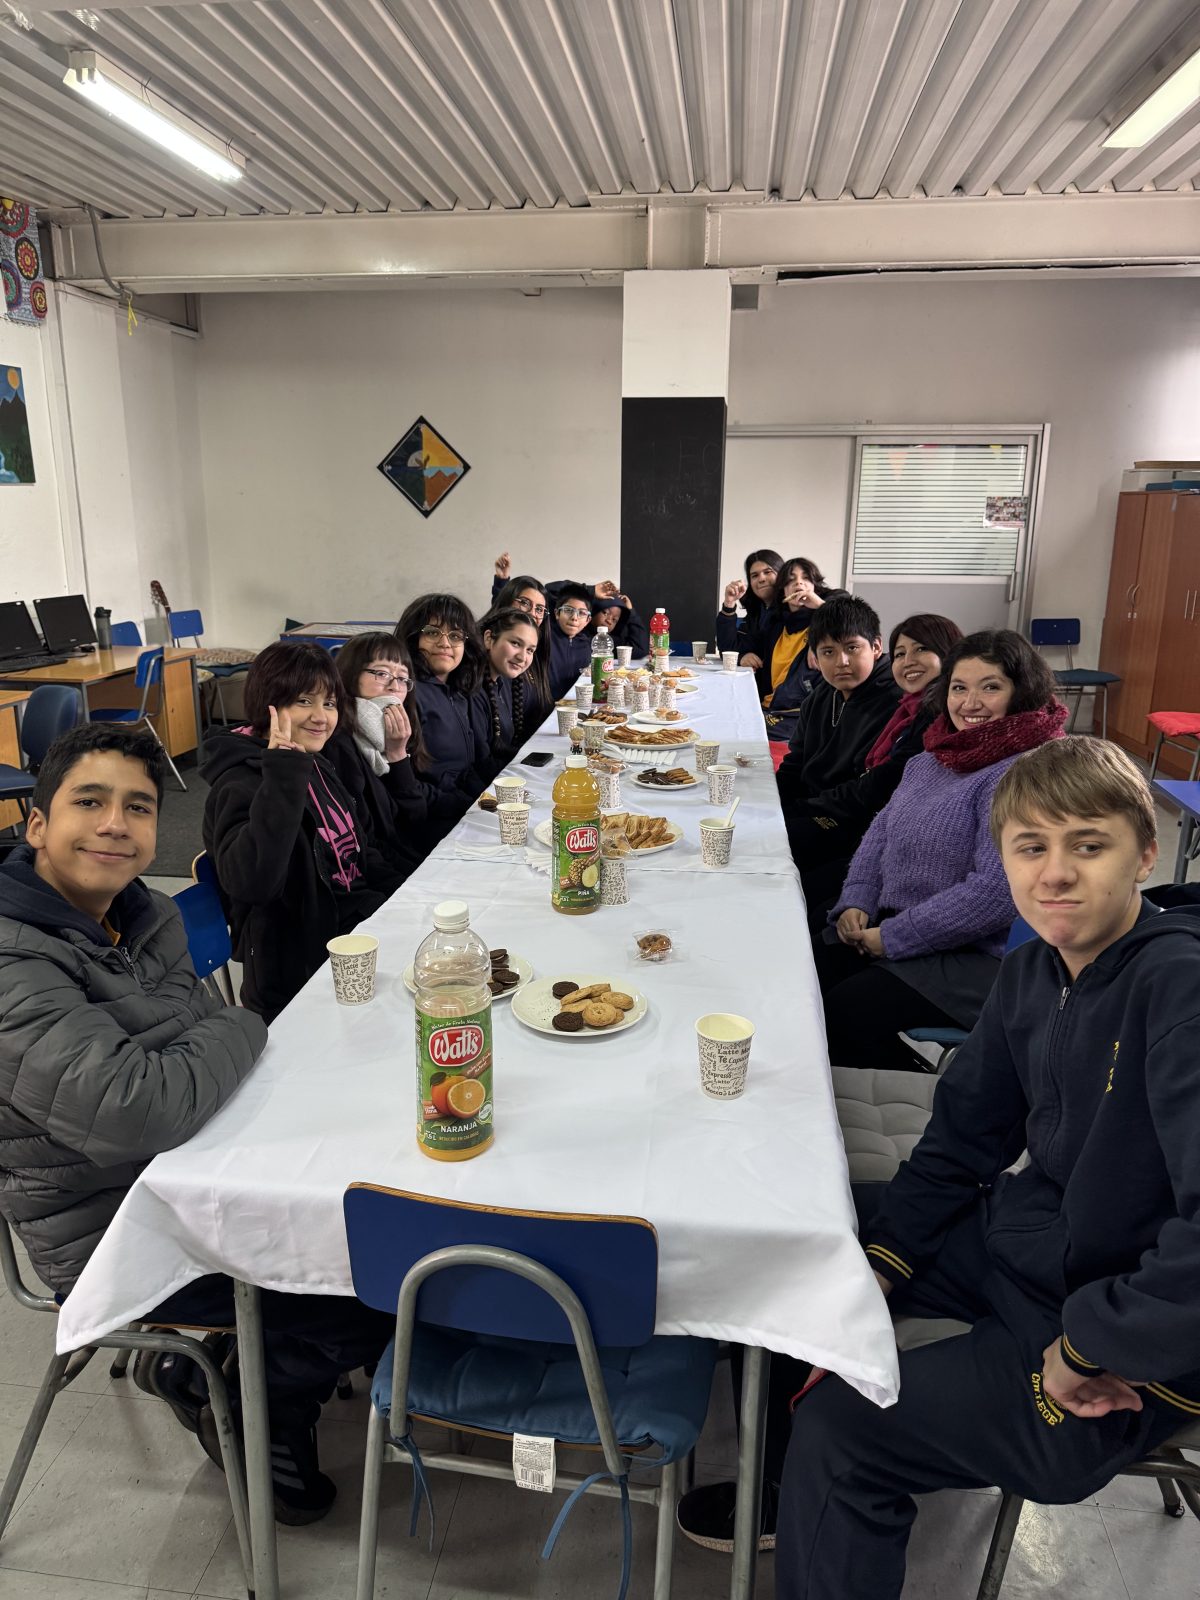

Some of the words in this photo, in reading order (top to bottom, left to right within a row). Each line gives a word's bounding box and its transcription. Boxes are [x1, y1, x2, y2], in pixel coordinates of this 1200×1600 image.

[569, 829, 597, 850] Watt's
[434, 1029, 479, 1062] Watt's
[440, 1121, 478, 1133] NARANJA
